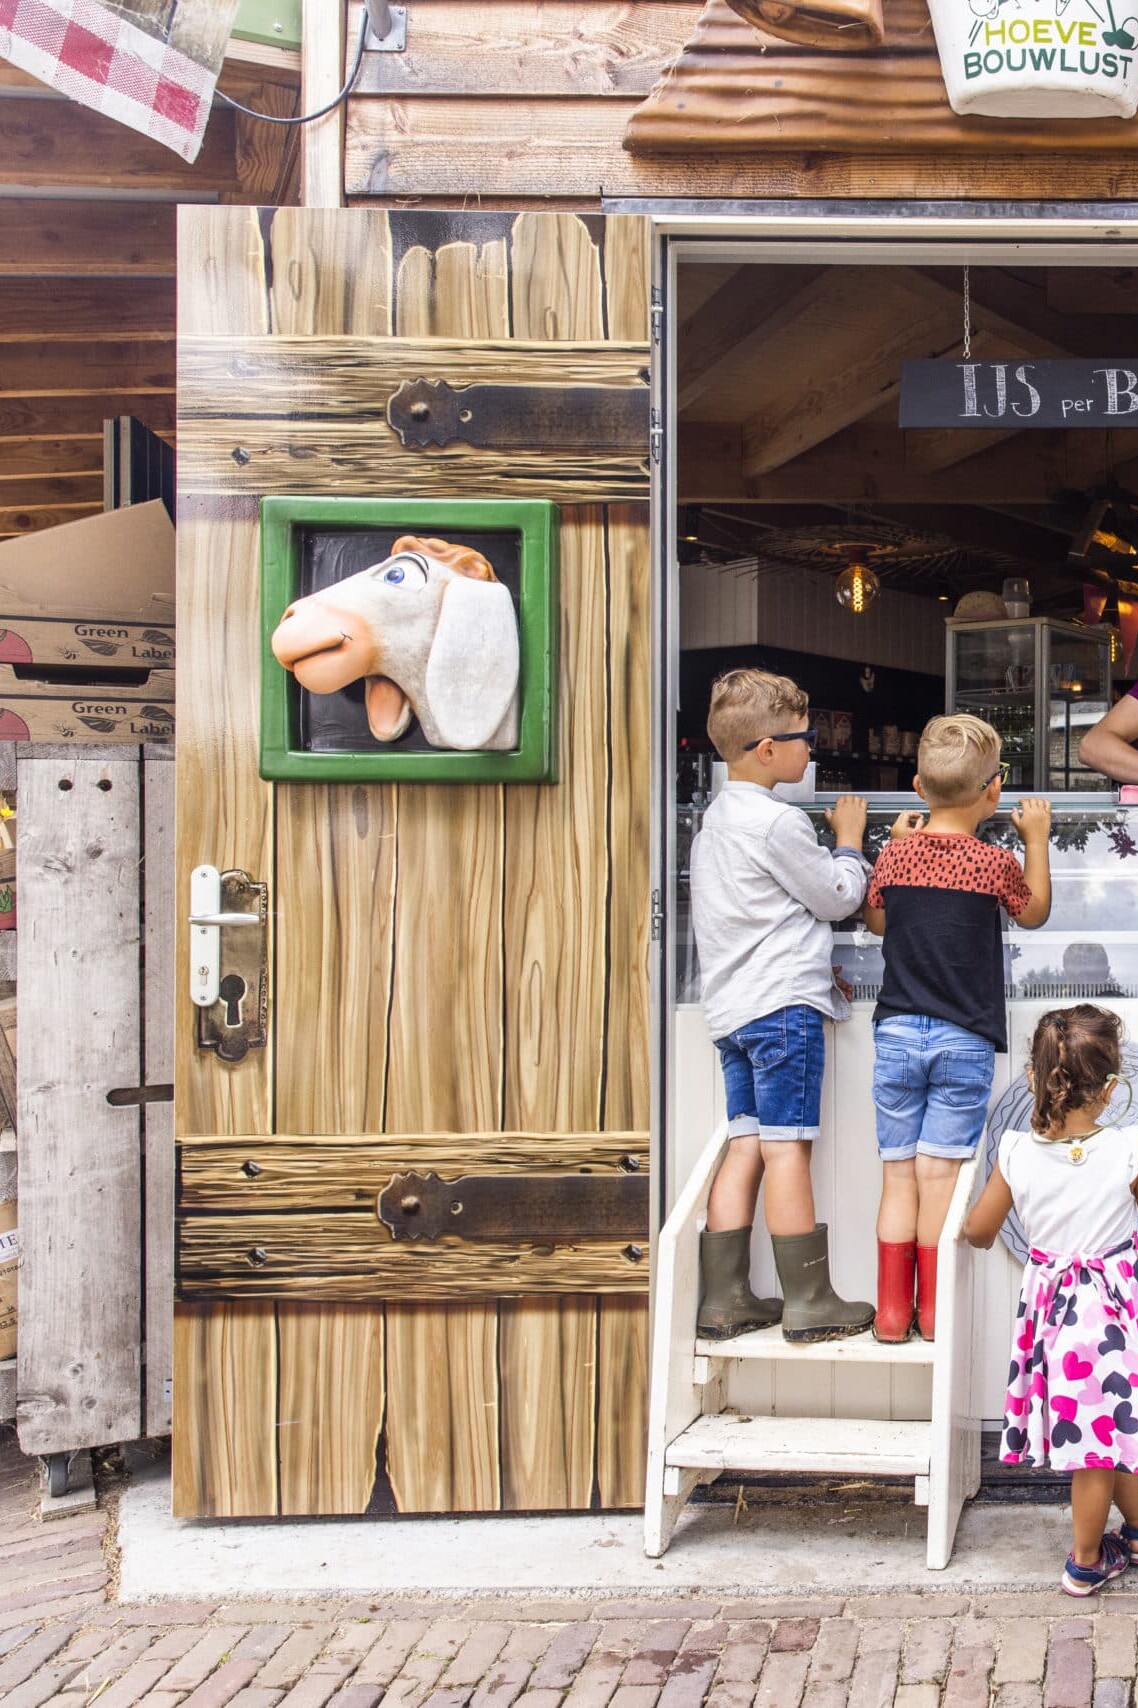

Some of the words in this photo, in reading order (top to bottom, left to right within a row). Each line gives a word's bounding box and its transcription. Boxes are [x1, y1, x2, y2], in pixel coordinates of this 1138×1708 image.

[984, 19, 1097, 46] HOEVE
[963, 48, 1133, 80] BOUWLUST
[956, 364, 1041, 418] IJS
[1062, 397, 1094, 418] per
[74, 624, 129, 638] Green
[71, 701, 127, 715] Green
